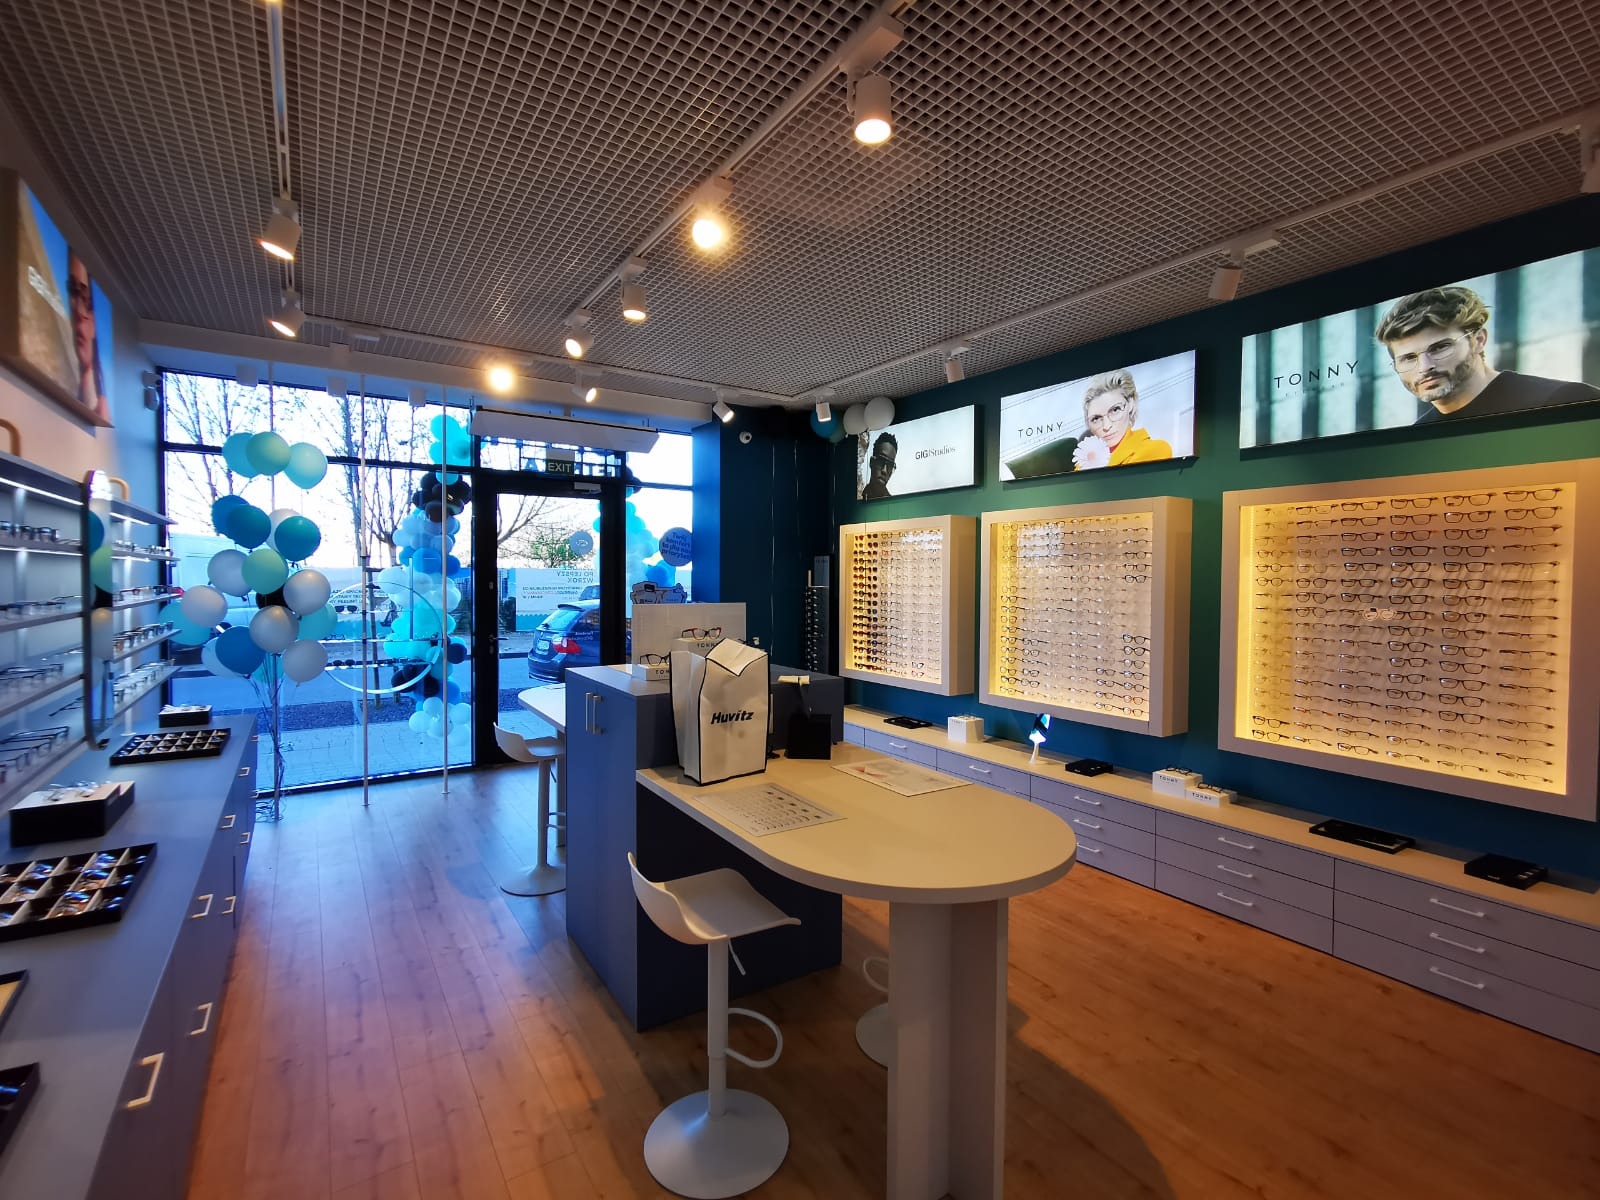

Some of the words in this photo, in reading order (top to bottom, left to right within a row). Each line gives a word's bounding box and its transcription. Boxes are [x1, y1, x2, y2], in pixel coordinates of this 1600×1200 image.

[1273, 359, 1359, 390] TONNY
[1017, 421, 1063, 439] TONNY
[547, 462, 571, 473] EXIT
[710, 709, 755, 725] Huvitz
